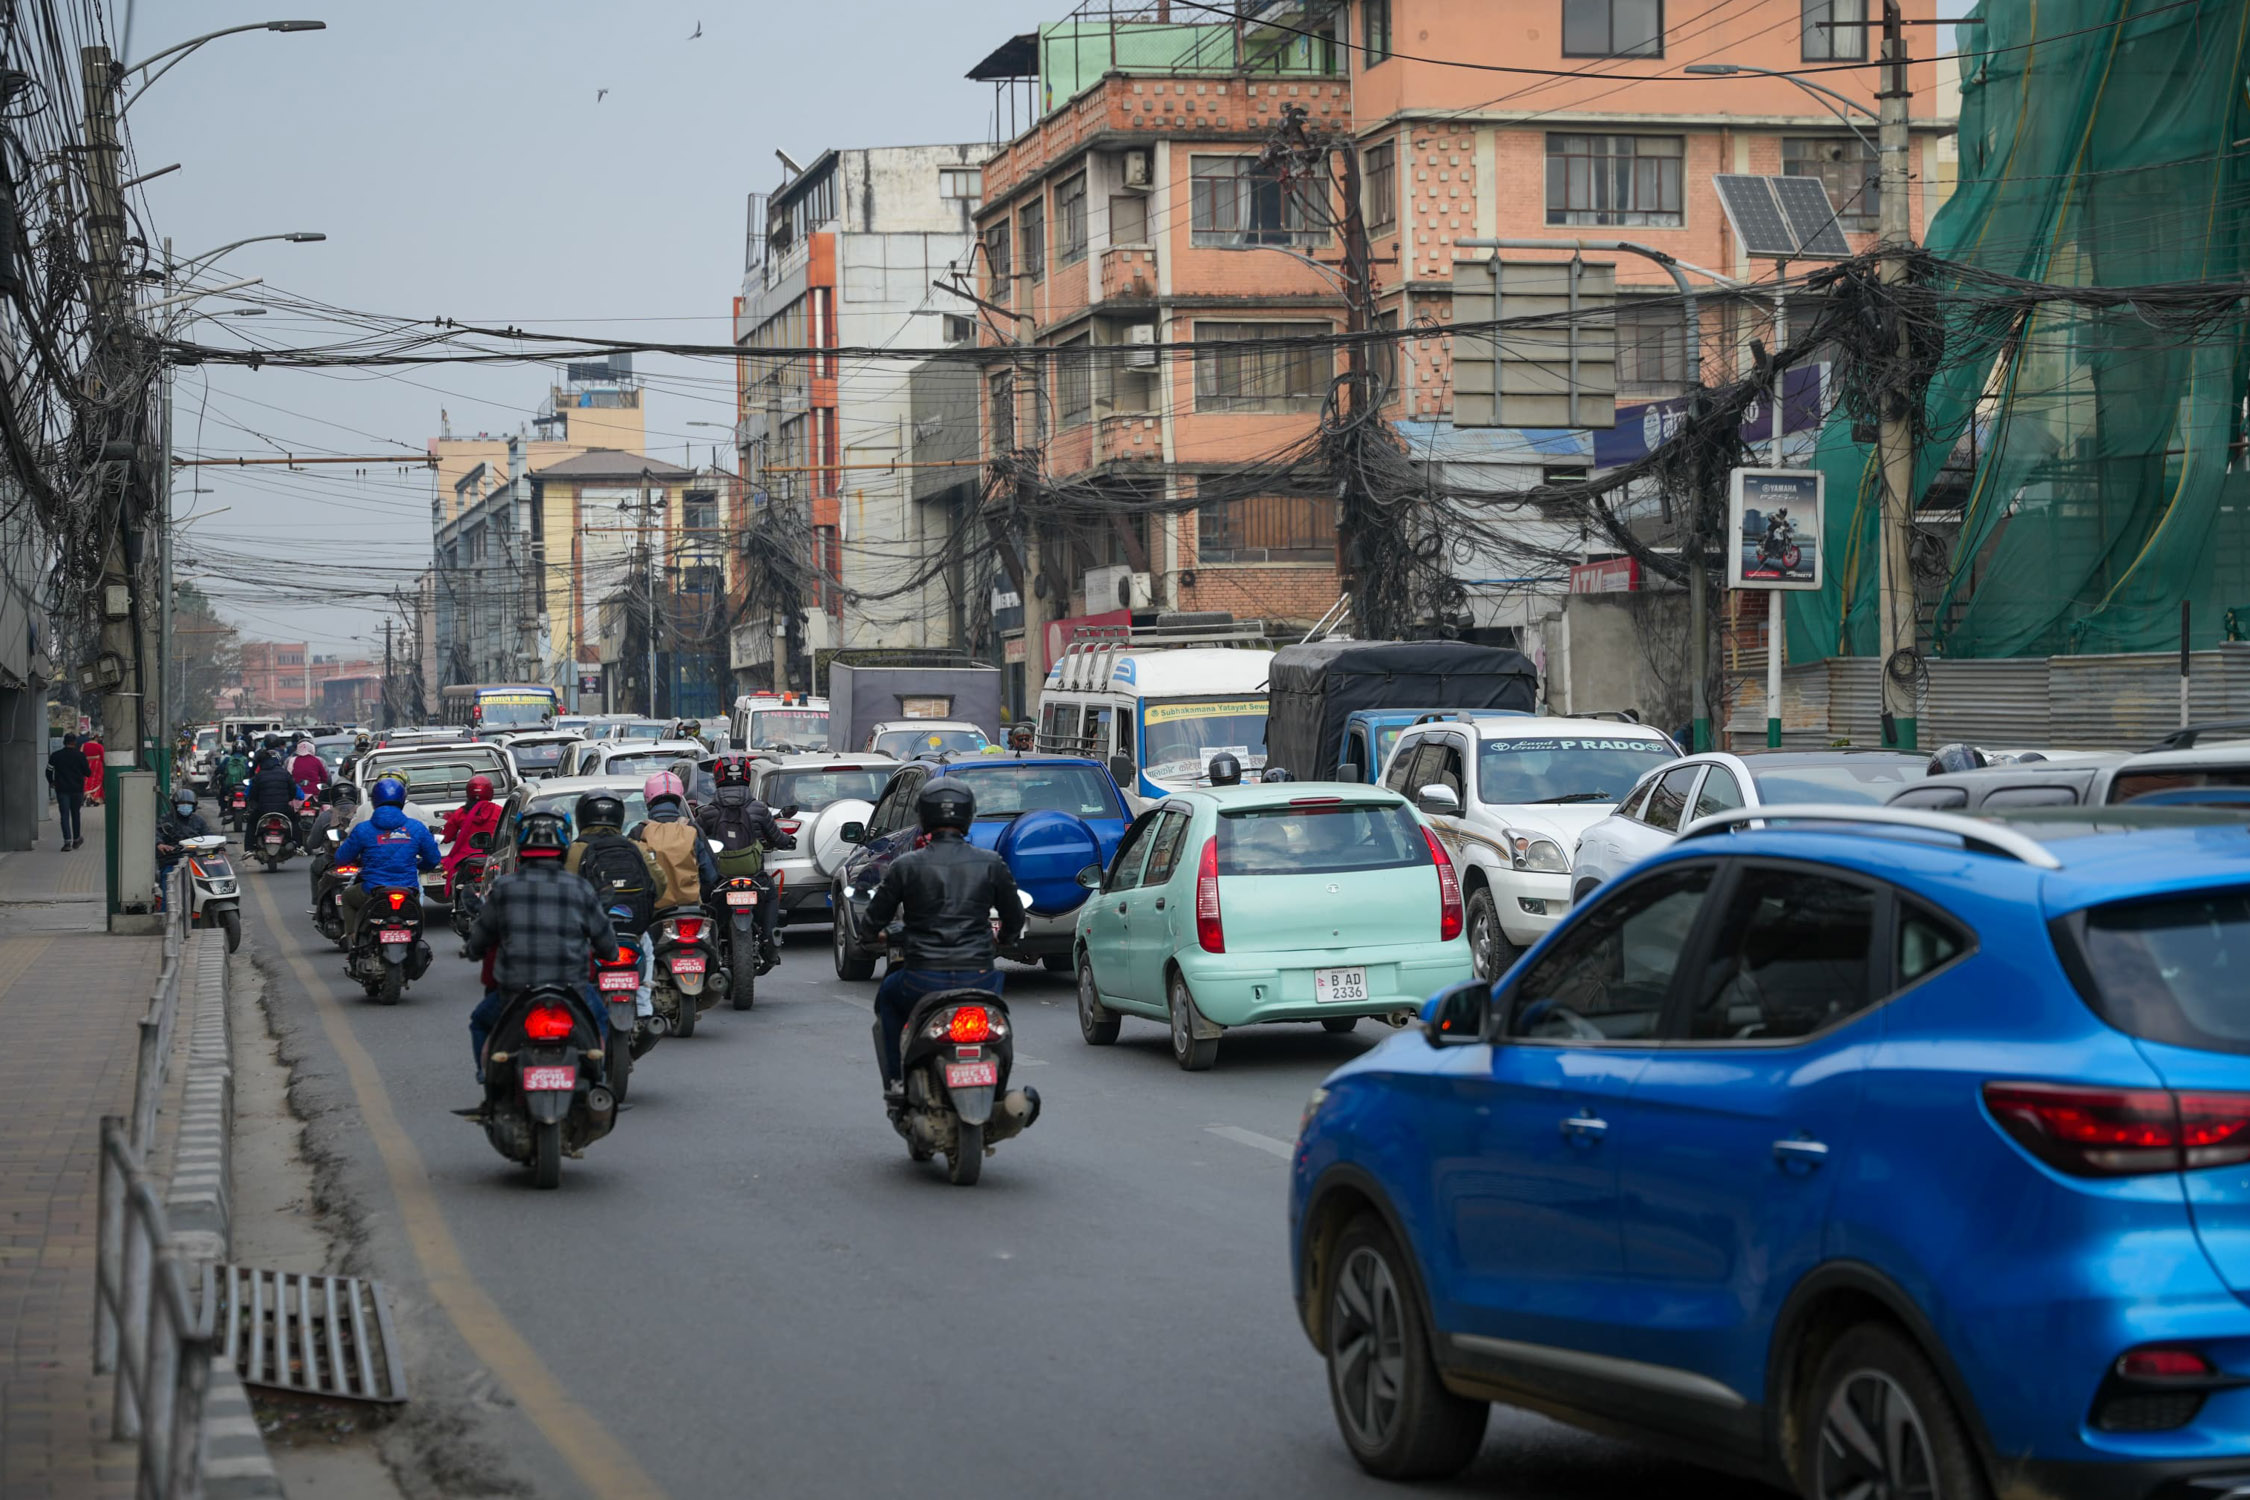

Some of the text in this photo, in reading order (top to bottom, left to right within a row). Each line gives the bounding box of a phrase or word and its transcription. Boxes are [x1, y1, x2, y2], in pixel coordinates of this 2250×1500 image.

[1770, 484, 1797, 492] YAMAHA
[1571, 568, 1603, 594] ATM
[1161, 706, 1216, 716] Subhakamana
[1218, 703, 1247, 712] Yatayat
[612, 879, 626, 887] CAT
[1331, 973, 1361, 986] B AD
[1332, 986, 1362, 999] 2336
